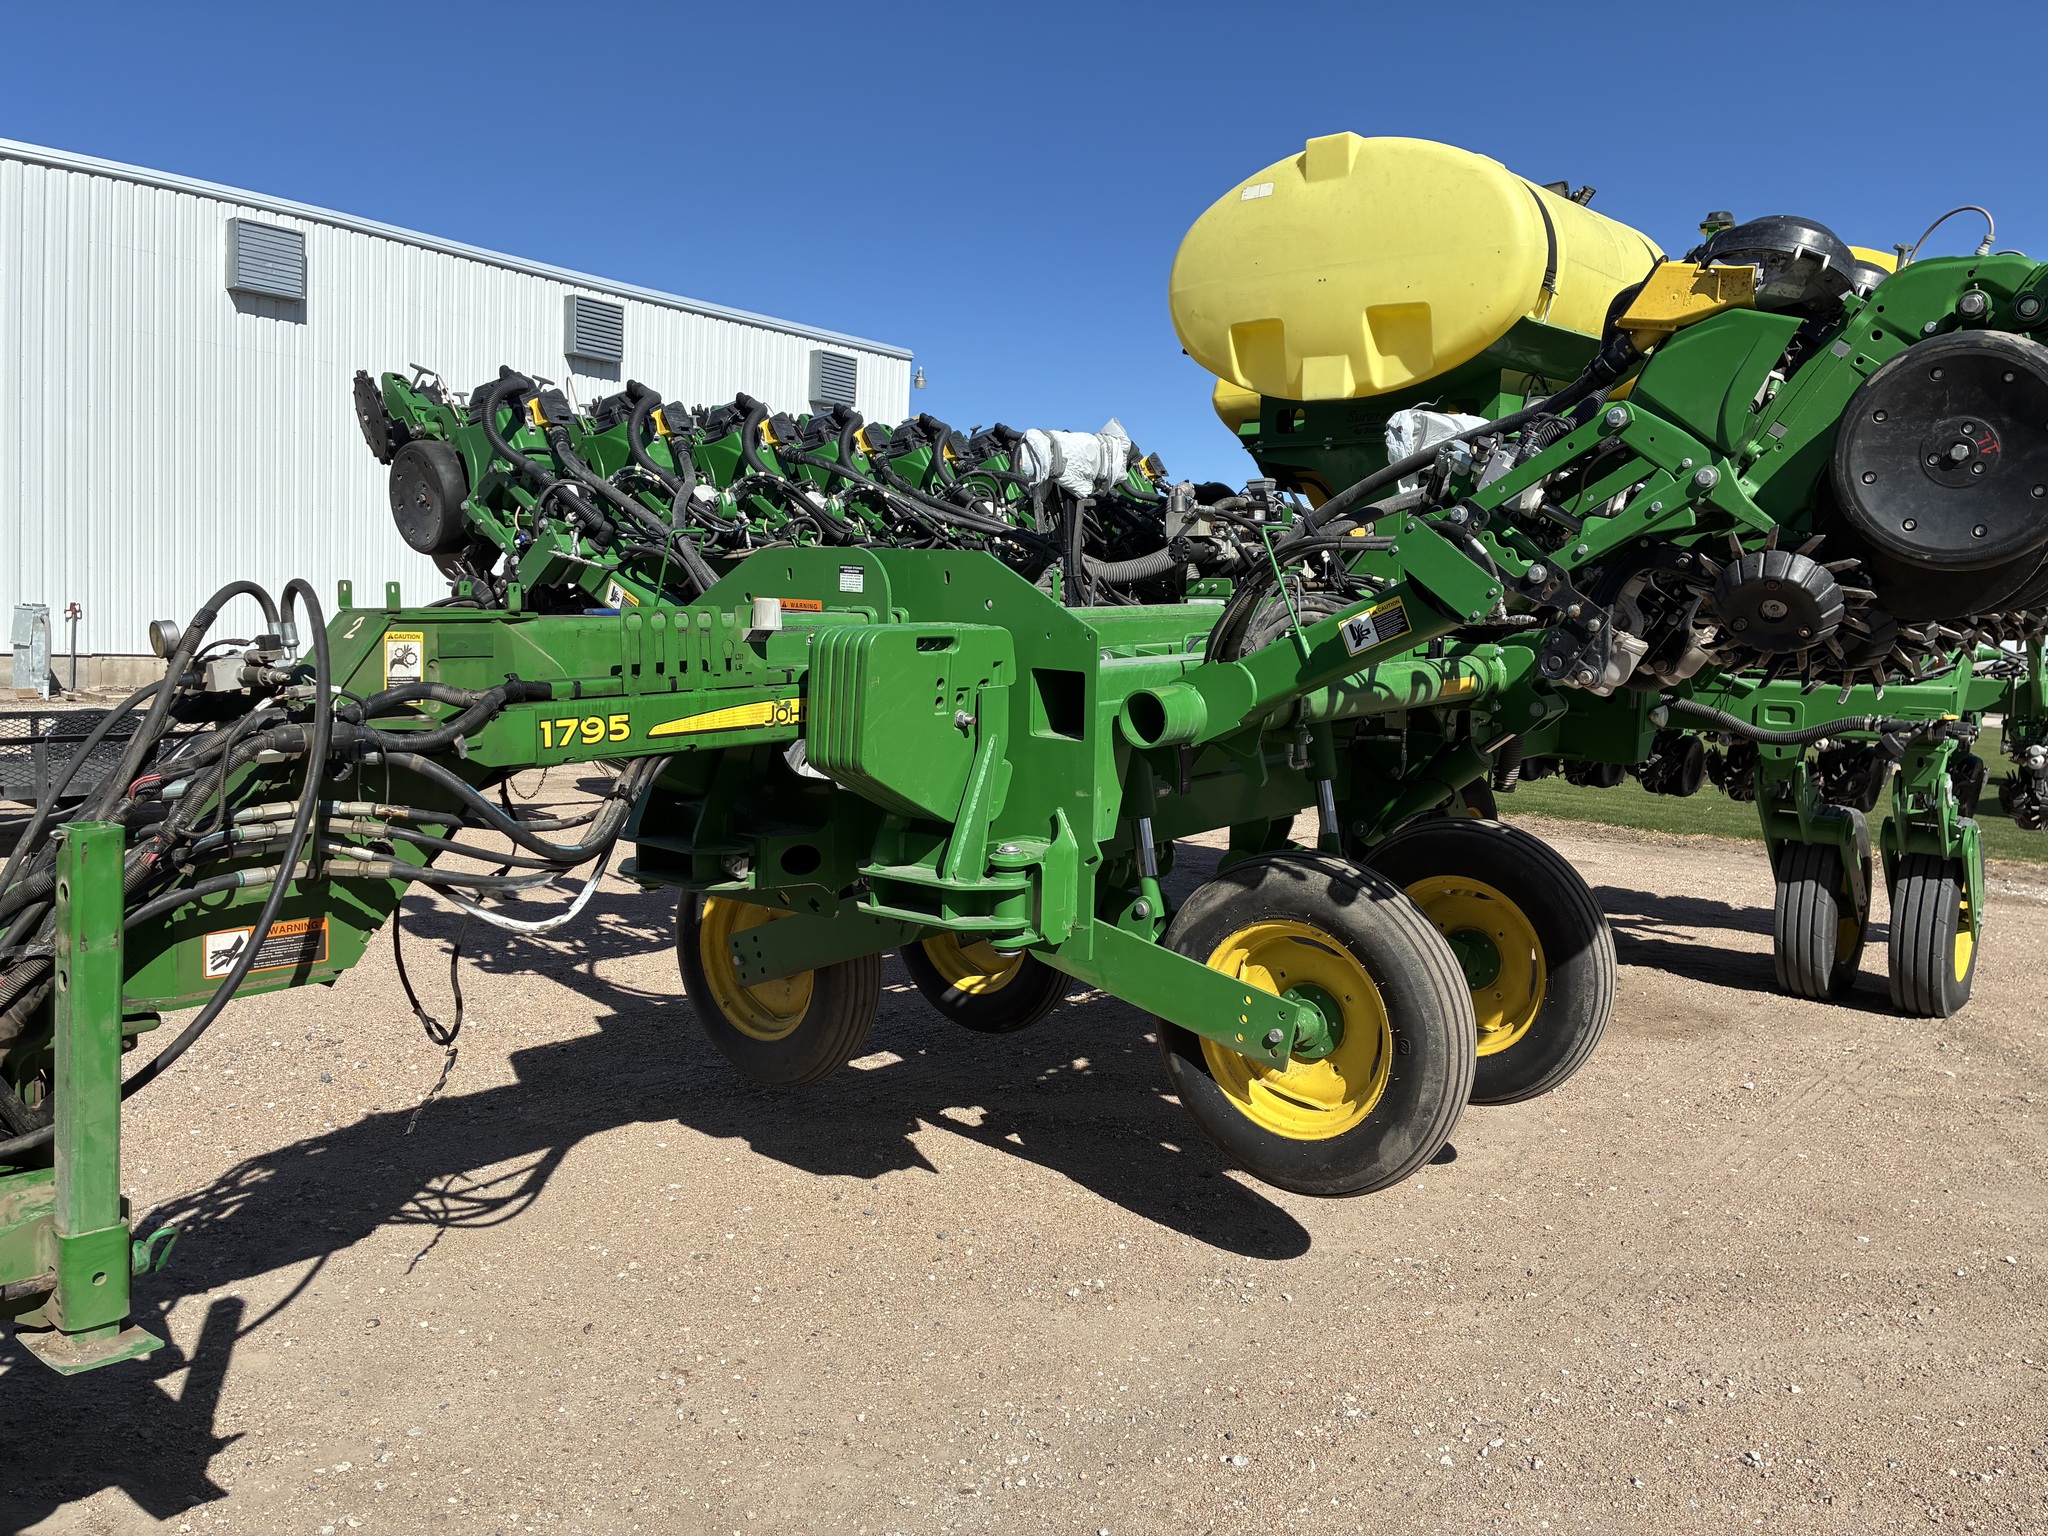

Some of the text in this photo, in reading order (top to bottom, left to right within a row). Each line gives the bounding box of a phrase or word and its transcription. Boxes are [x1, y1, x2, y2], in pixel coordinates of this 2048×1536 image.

[790, 602, 818, 610] WARNING
[1377, 600, 1400, 612] CAUTION
[342, 616, 366, 639] 2
[539, 713, 631, 749] 1795
[269, 921, 319, 935] WARNING
